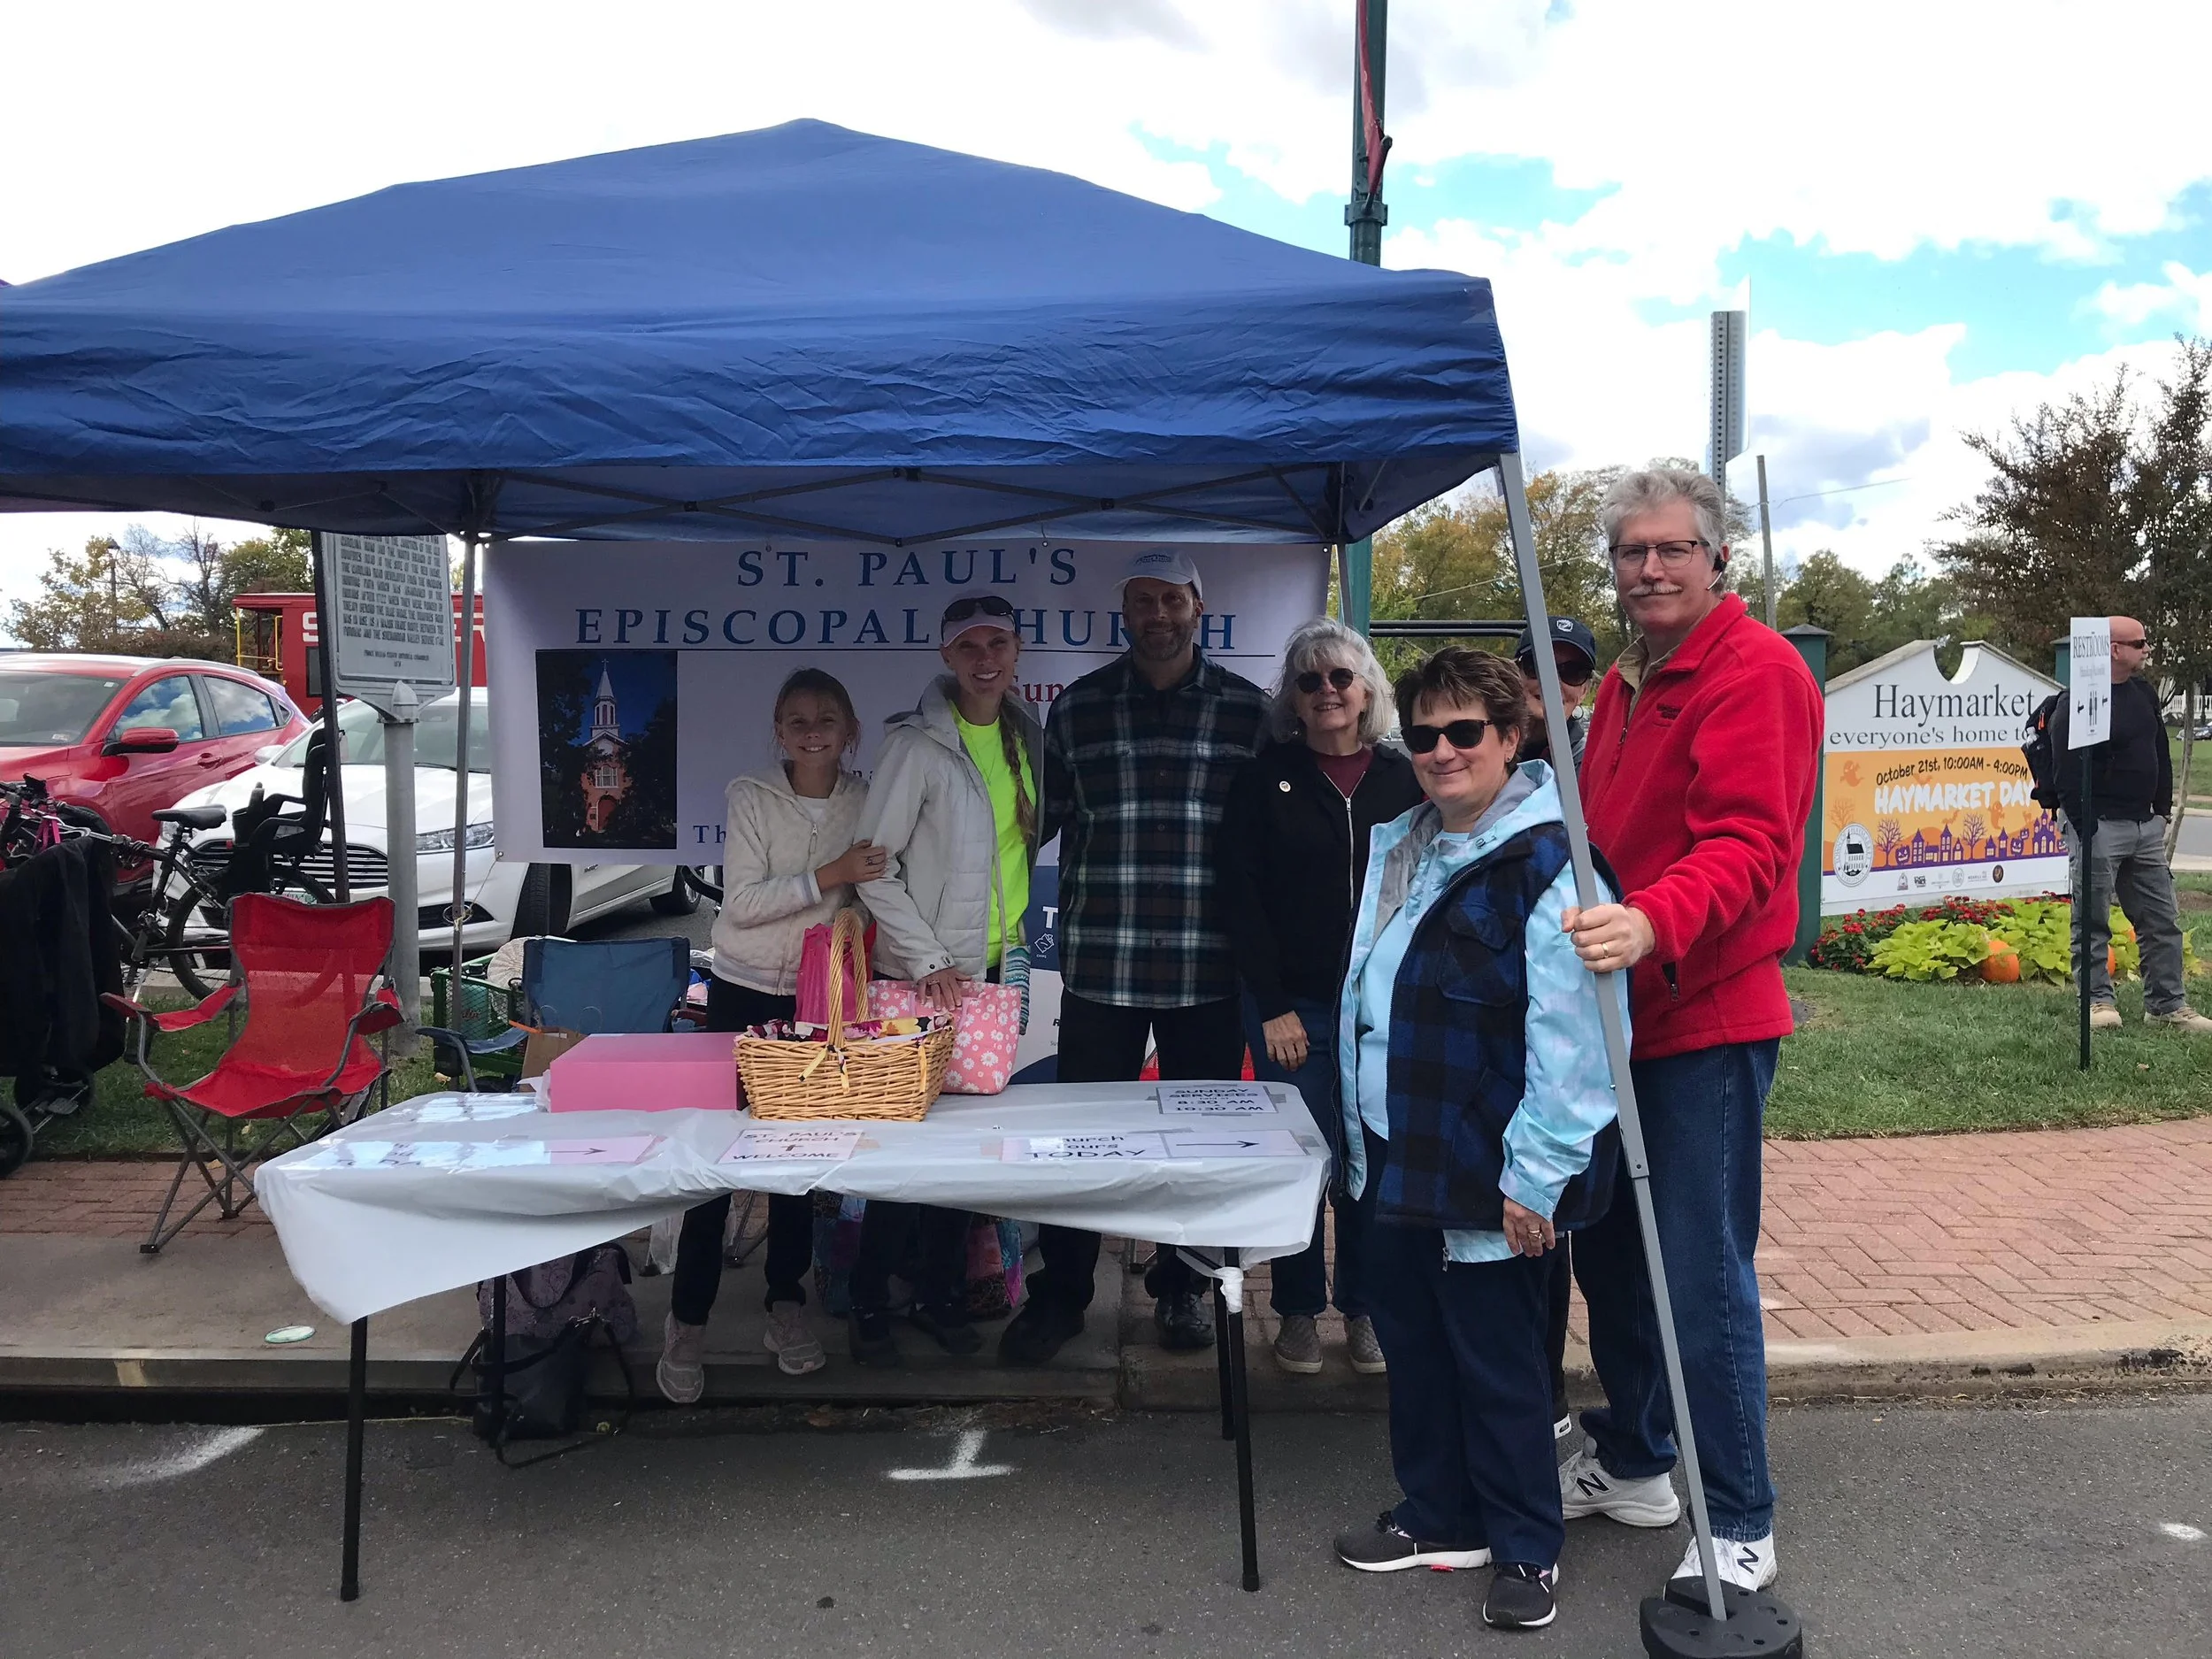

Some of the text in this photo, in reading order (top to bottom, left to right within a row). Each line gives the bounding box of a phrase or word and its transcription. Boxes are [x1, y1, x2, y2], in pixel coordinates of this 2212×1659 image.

[737, 548, 1077, 587] ST. PAUL'S
[575, 608, 1236, 649] EPISCOPAL HURH
[2073, 635, 2109, 658] RESTROOMS
[1872, 684, 2034, 727] Haymarket
[1829, 726, 1945, 749] everyone's
[1953, 726, 2008, 742] home
[1876, 764, 1916, 786] October
[1918, 757, 1941, 773] 21st,
[1943, 757, 1984, 771] 10:00AM
[1993, 759, 2028, 780] 4:00PM
[1874, 779, 2034, 815] HAYMARKET DAY
[1025, 1149, 1146, 1158] TODAY
[1577, 1472, 1609, 1498] N
